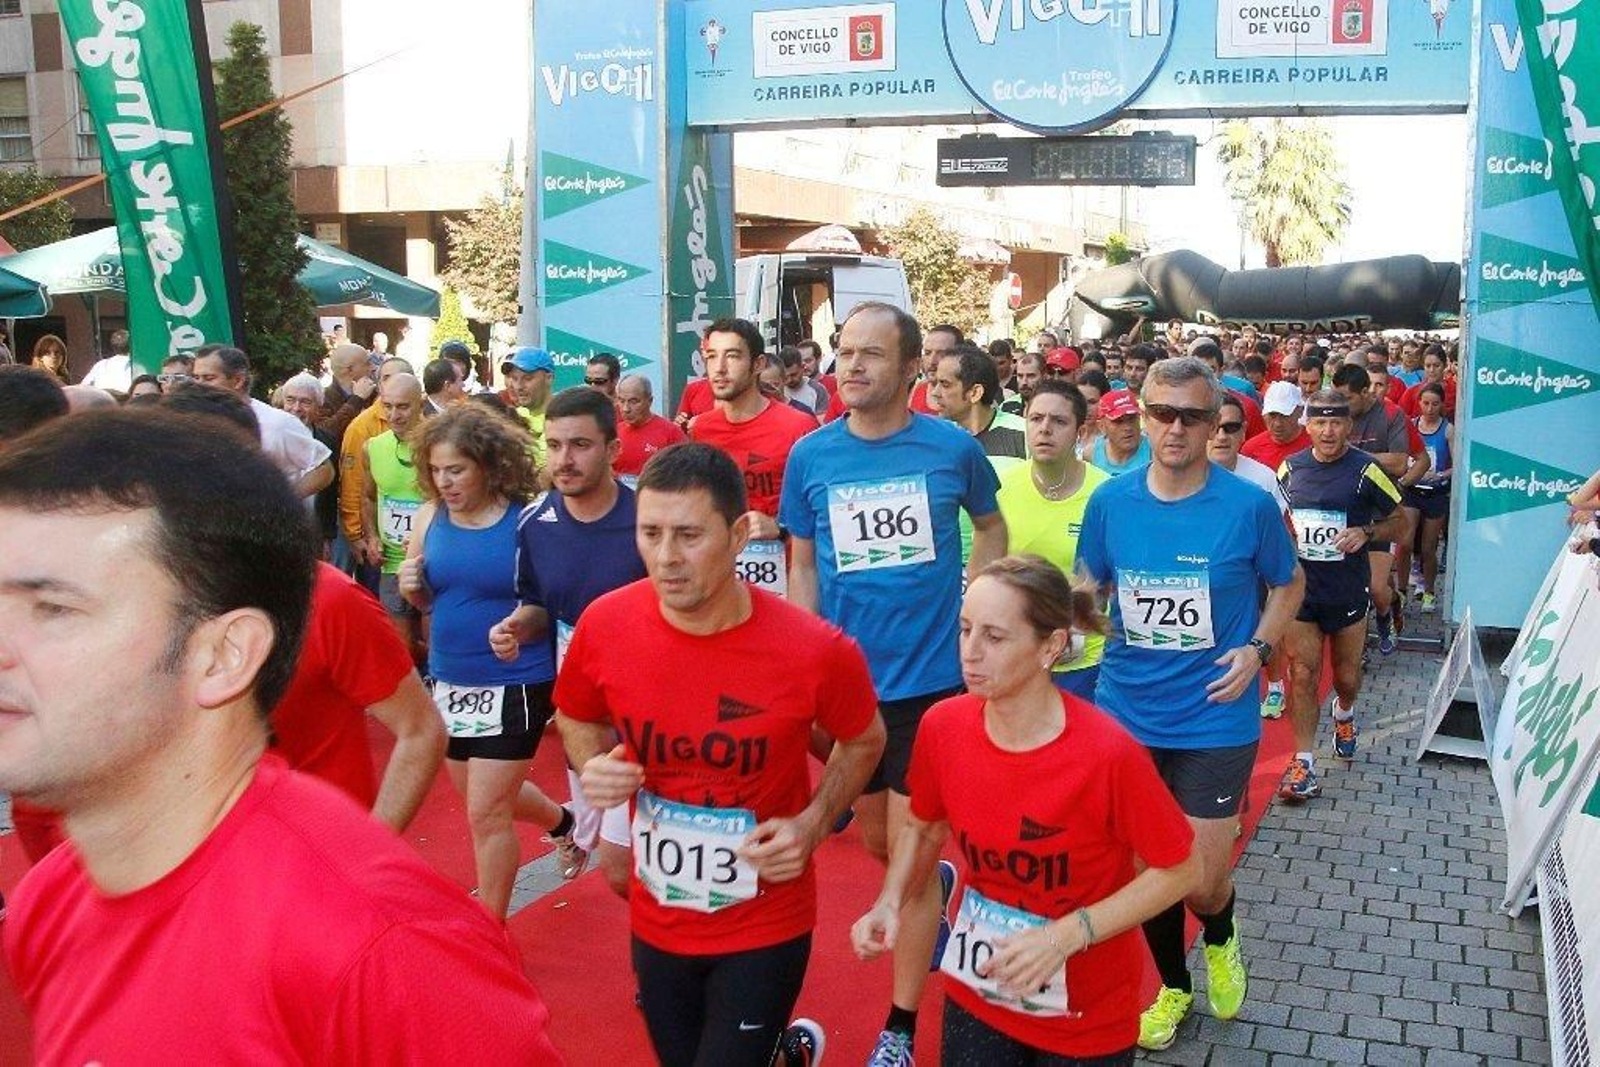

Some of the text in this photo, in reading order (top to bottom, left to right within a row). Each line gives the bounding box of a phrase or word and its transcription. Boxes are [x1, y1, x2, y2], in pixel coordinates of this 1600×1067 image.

[1239, 6, 1321, 20] CONCELLO
[771, 28, 838, 42] CONCELLO
[1249, 21, 1311, 35] DE VIGO
[779, 41, 831, 56] DE VIGO
[1069, 70, 1112, 81] Trofeo
[1174, 66, 1388, 85] CARREIRA POPULAR
[754, 79, 935, 101] CARREIRA POPULAR
[992, 72, 1124, 107] El Corte Inglés
[1487, 156, 1503, 173] El
[1504, 157, 1543, 174] Corte
[557, 176, 585, 190] Corte
[559, 265, 586, 279] Corte
[1482, 262, 1498, 280] El
[1500, 264, 1538, 281] Corte
[1477, 366, 1591, 394] El Corte Inglés
[1471, 471, 1487, 488] El
[1488, 473, 1526, 490] Corte
[391, 513, 411, 531] 71
[852, 505, 918, 542] 186
[1302, 527, 1338, 546] 169
[1137, 598, 1199, 626] 726
[448, 689, 494, 715] 898
[639, 831, 738, 884] 1013
